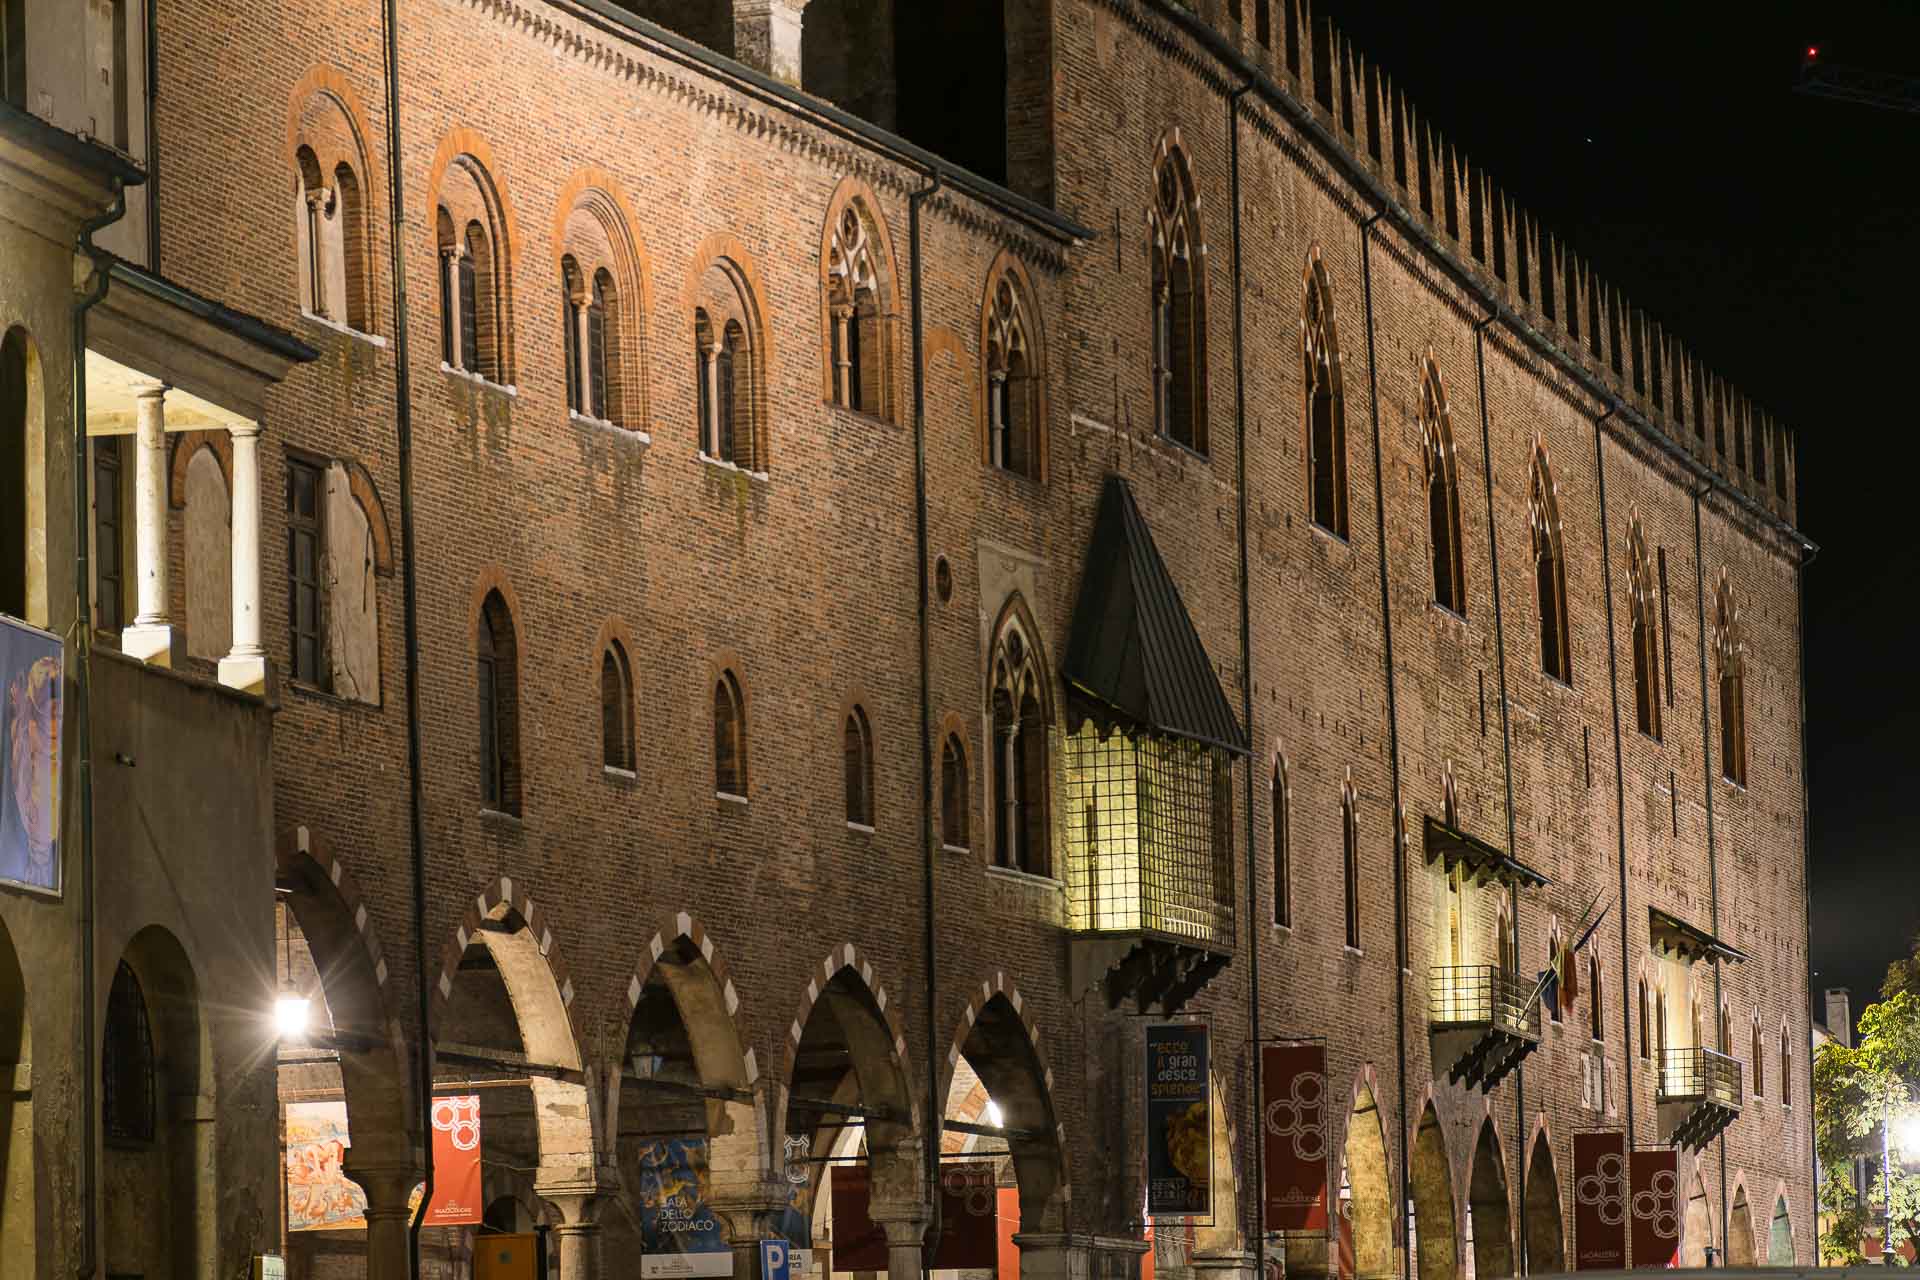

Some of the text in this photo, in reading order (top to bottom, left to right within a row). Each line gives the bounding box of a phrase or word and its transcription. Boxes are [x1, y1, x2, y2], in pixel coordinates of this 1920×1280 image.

[1168, 1055, 1197, 1071] gran
[1158, 1068, 1198, 1081] desco
[661, 1208, 695, 1220] DELLO
[661, 1220, 714, 1233] ZODIACO
[767, 1245, 784, 1280] P
